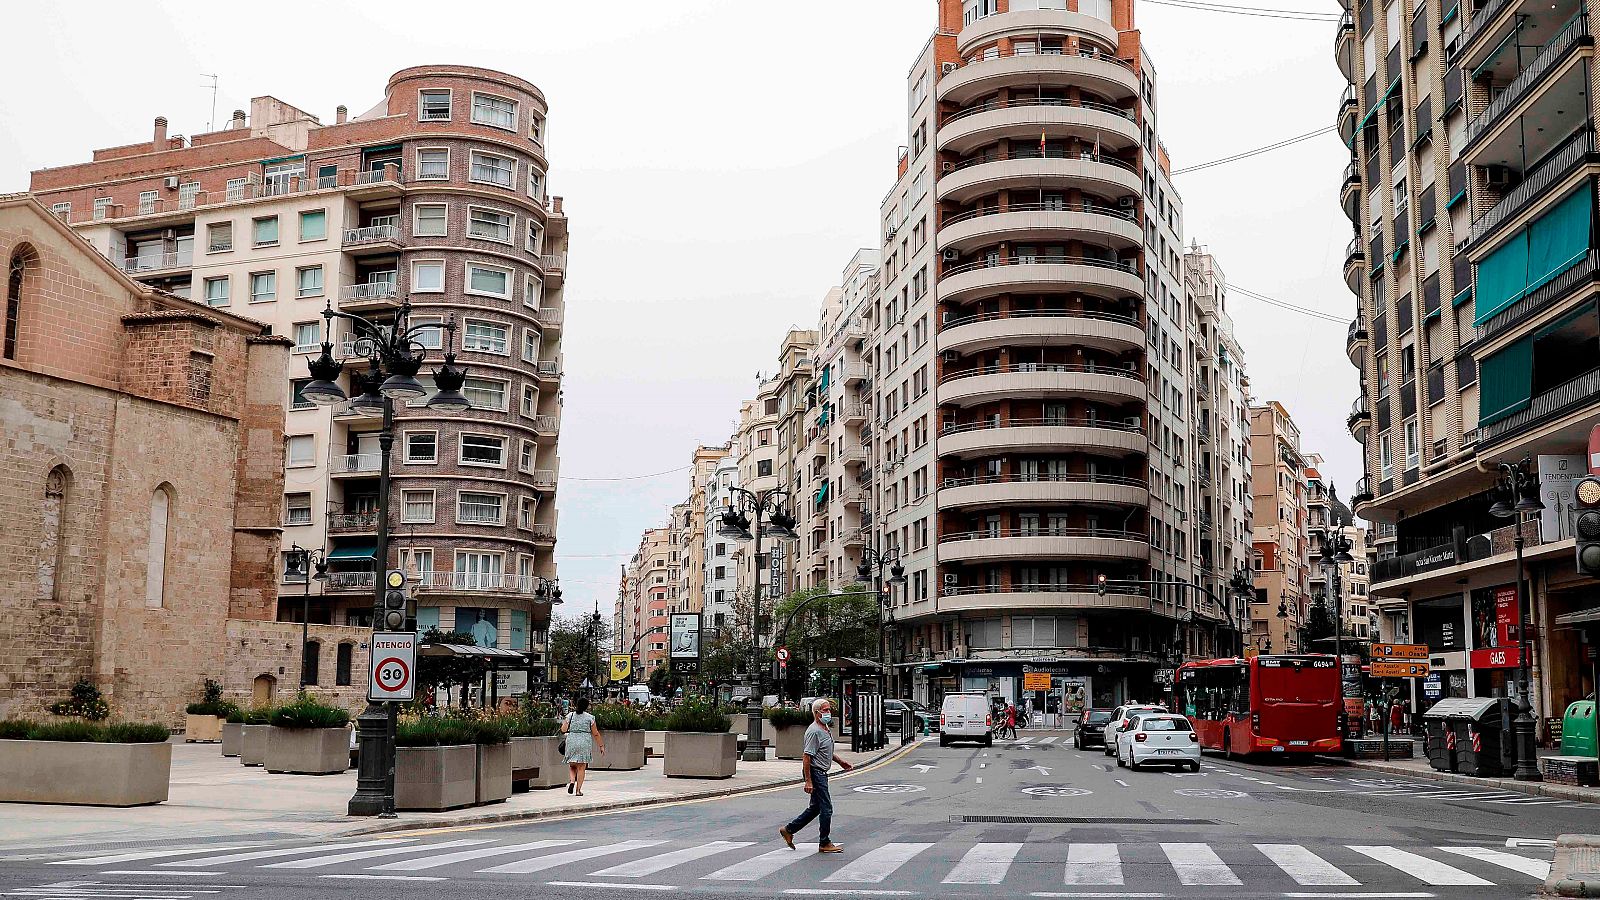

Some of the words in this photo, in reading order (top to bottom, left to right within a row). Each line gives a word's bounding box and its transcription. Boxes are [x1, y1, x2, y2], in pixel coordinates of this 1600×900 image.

[771, 548, 780, 597] HOTEL
[375, 641, 412, 649] ATENCIÓ
[1385, 647, 1392, 655] P
[1490, 652, 1506, 665] GAES
[675, 662, 697, 671] 12:29
[382, 668, 402, 680] 30
